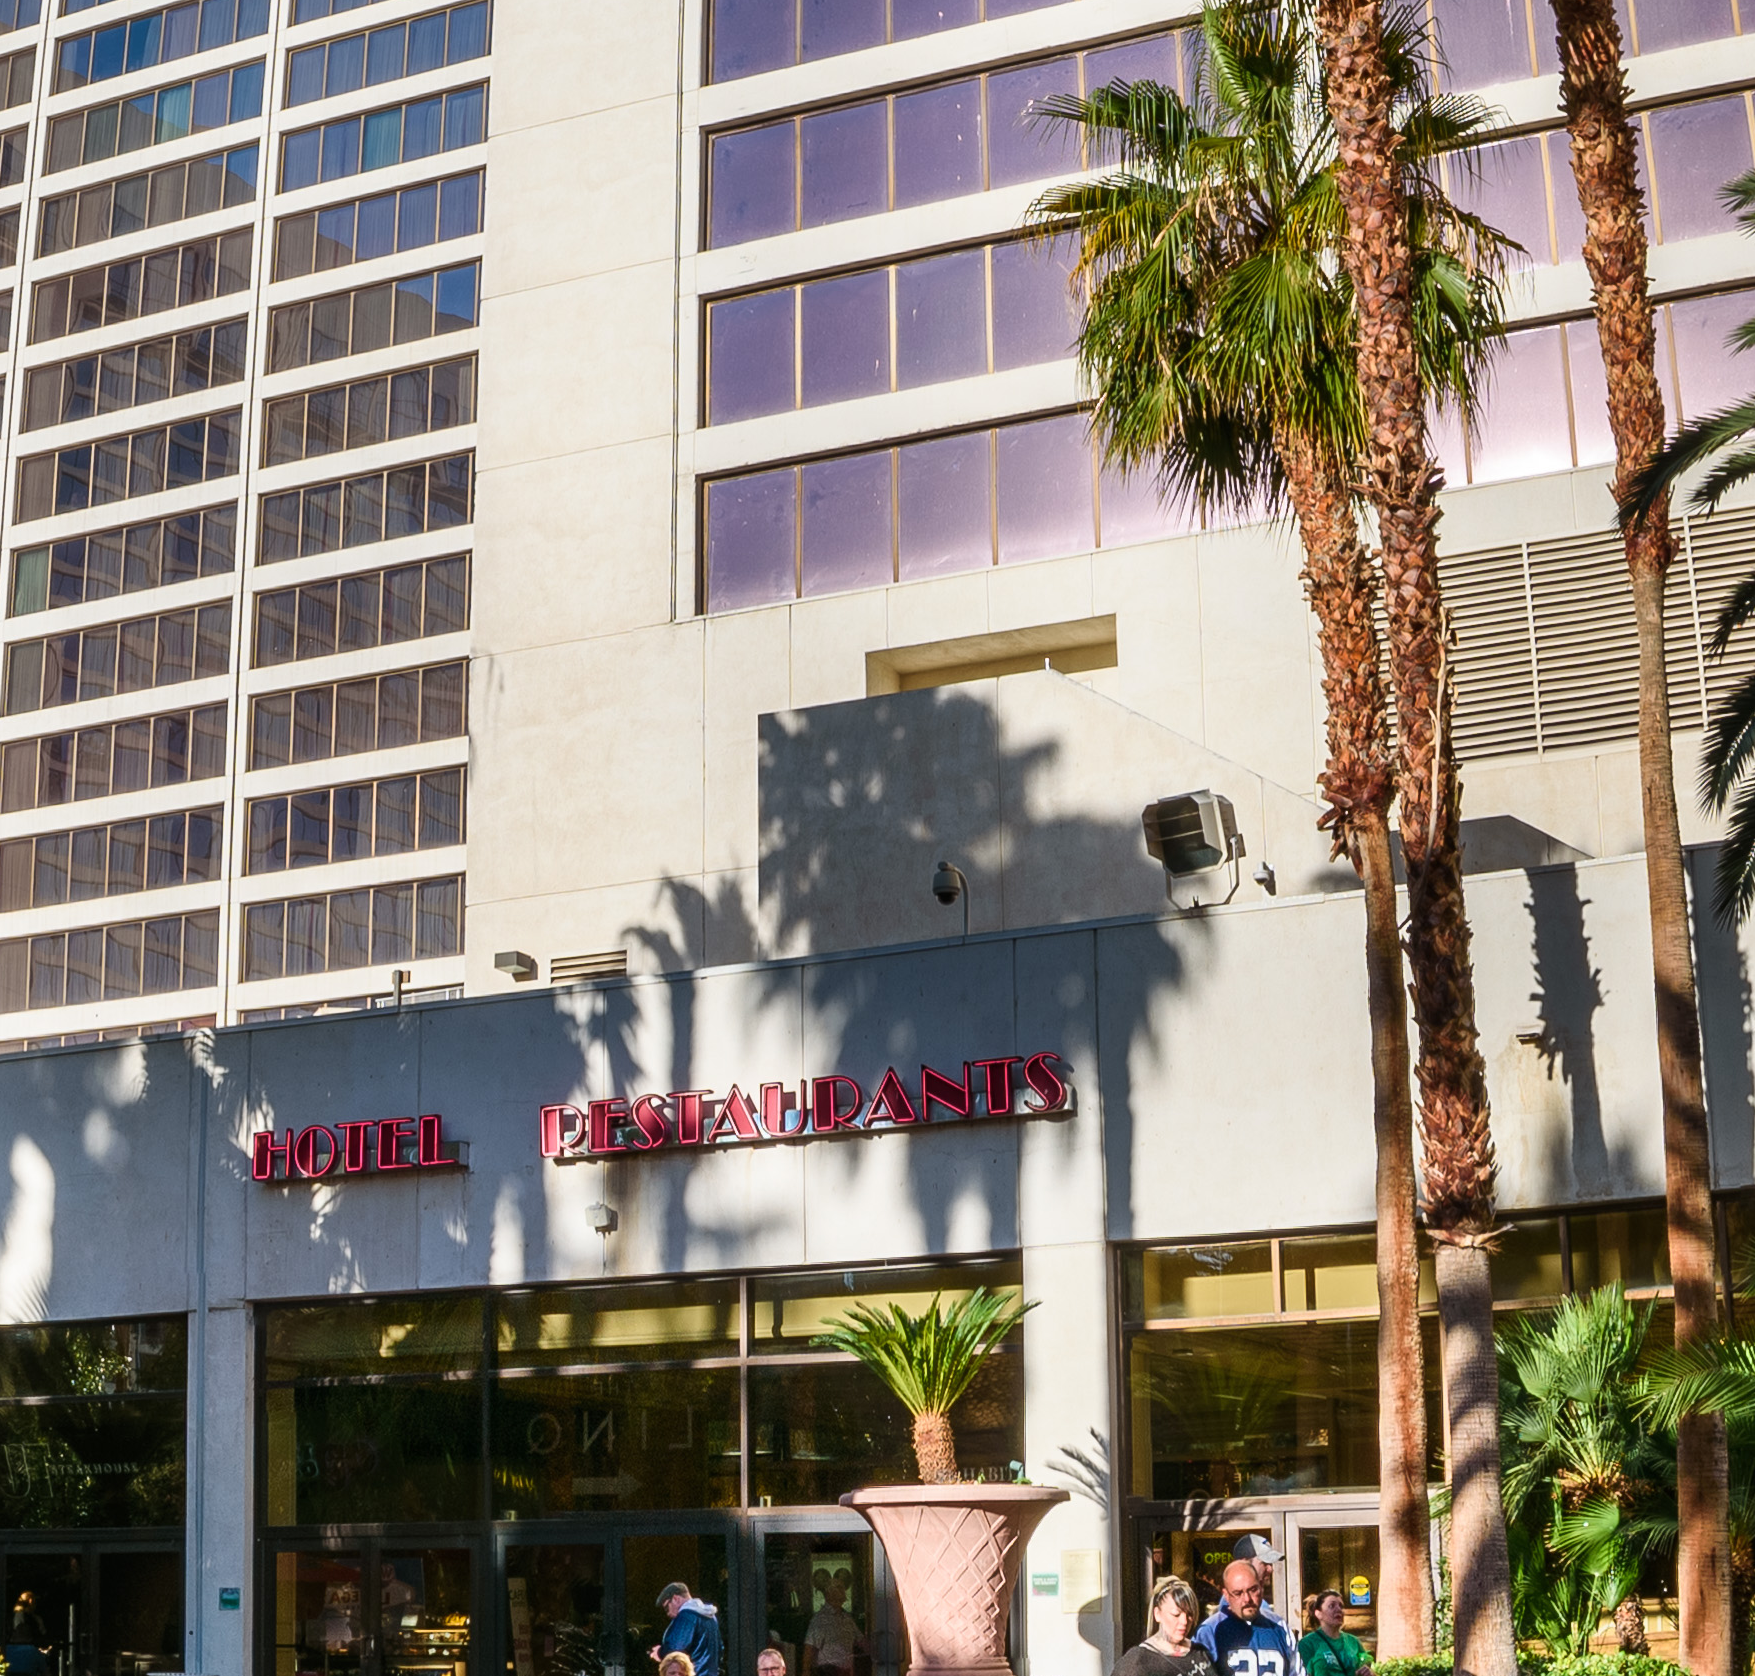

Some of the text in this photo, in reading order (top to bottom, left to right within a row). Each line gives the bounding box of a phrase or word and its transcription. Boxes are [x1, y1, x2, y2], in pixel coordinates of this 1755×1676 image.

[252, 1051, 1068, 1184] HOTEL RESTAURANTS
[48, 1461, 139, 1477] STEAKHOUSE
[1204, 1552, 1235, 1565] OPEN
